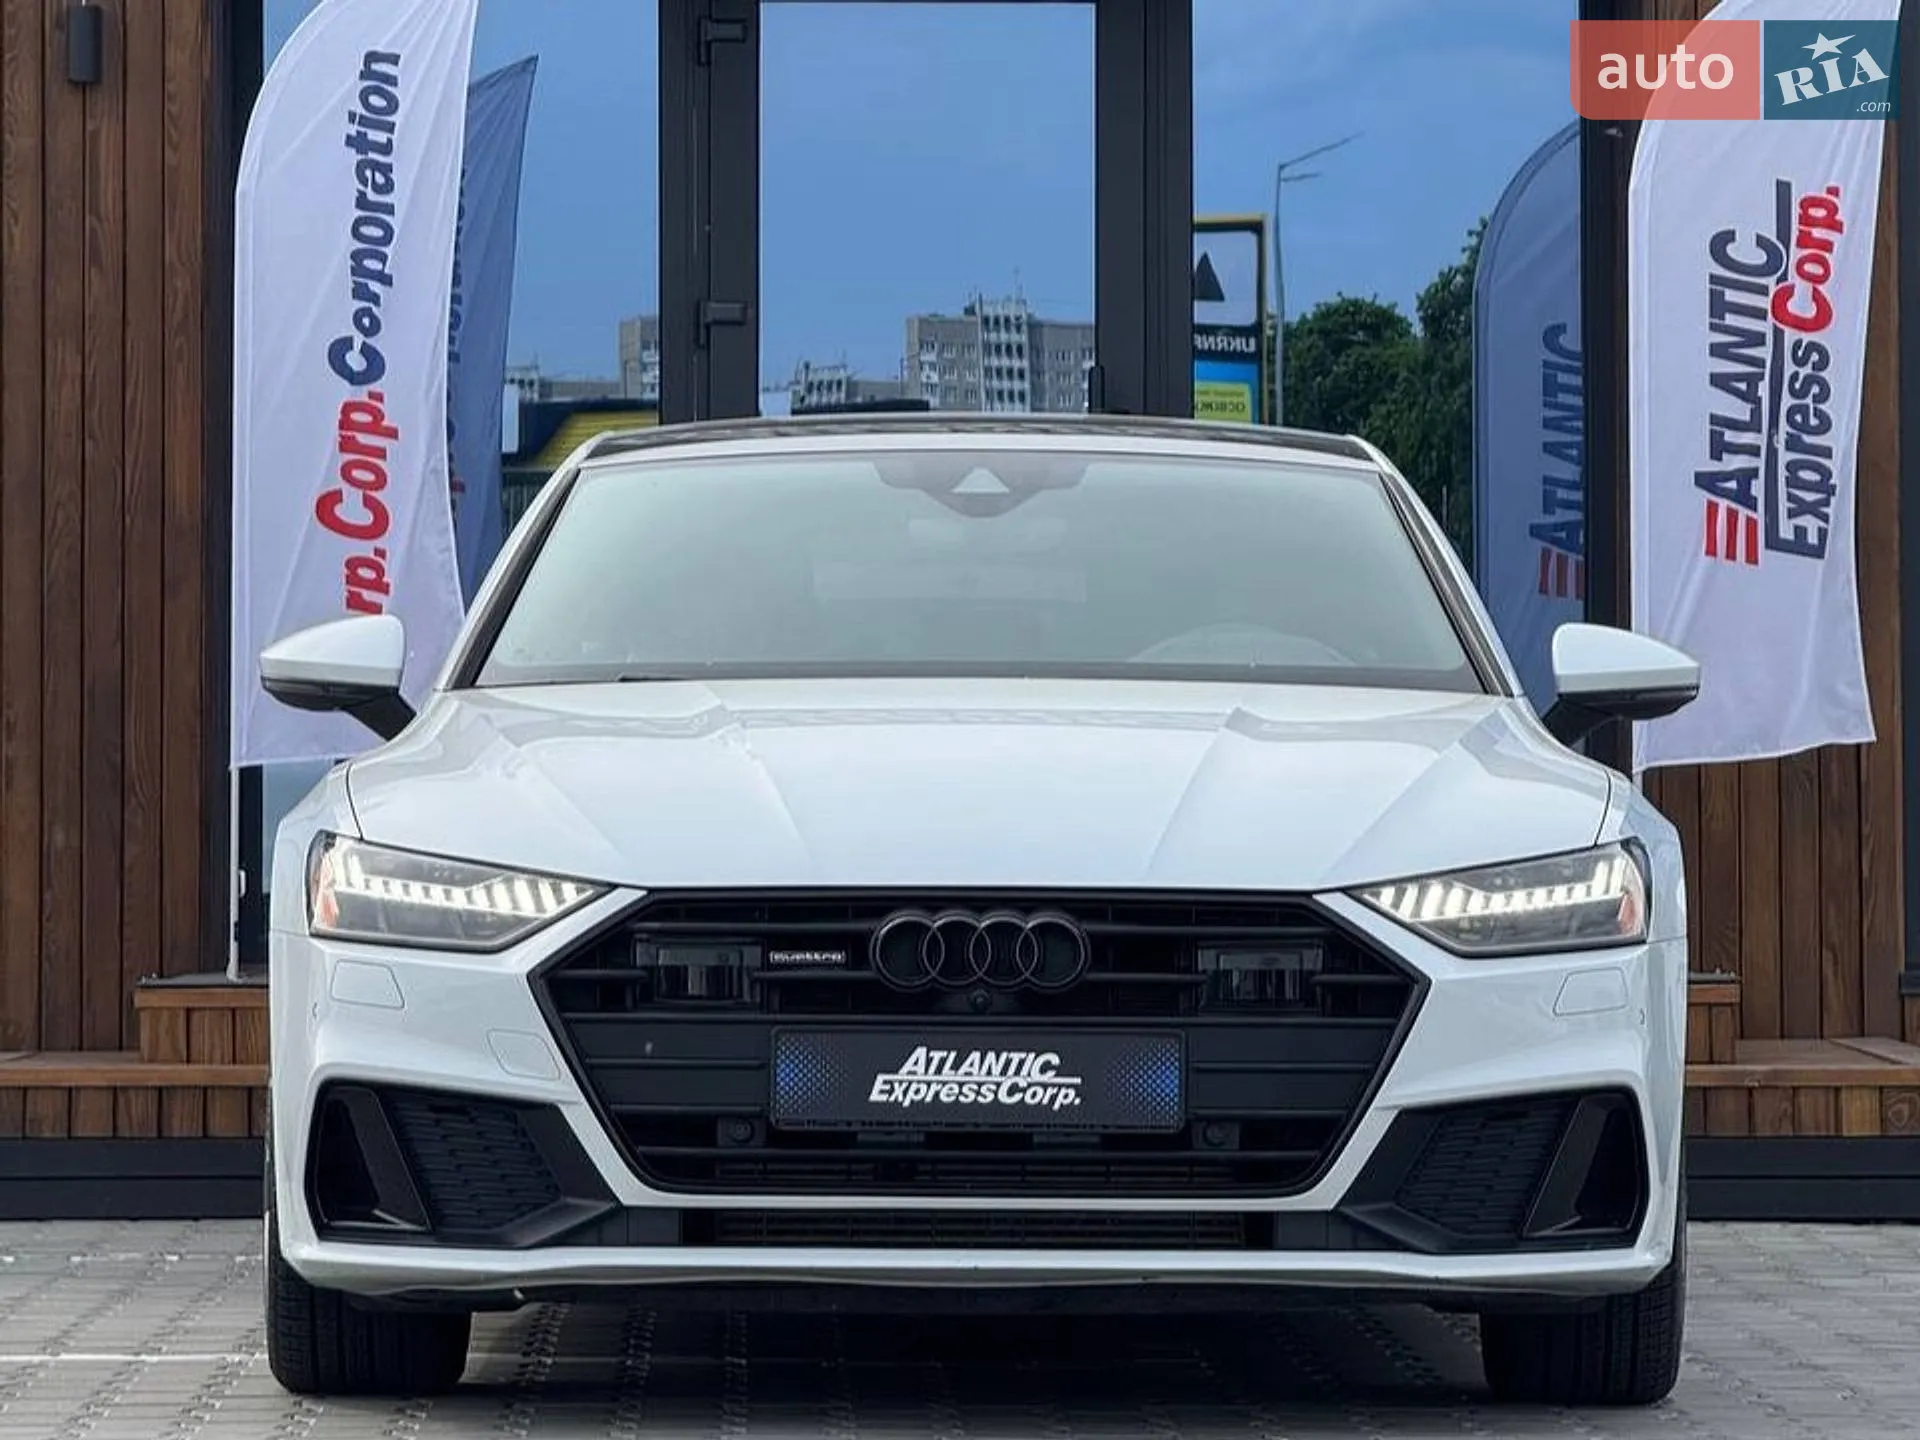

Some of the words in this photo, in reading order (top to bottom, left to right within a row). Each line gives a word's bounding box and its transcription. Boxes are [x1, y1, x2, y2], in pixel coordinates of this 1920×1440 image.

[328, 50, 401, 387] Corporation
[1529, 322, 1584, 557] ATLANTIC
[1693, 228, 1785, 512] ATLANTIC
[1771, 339, 1836, 560] Express
[898, 1046, 1061, 1078] ATLANTIC
